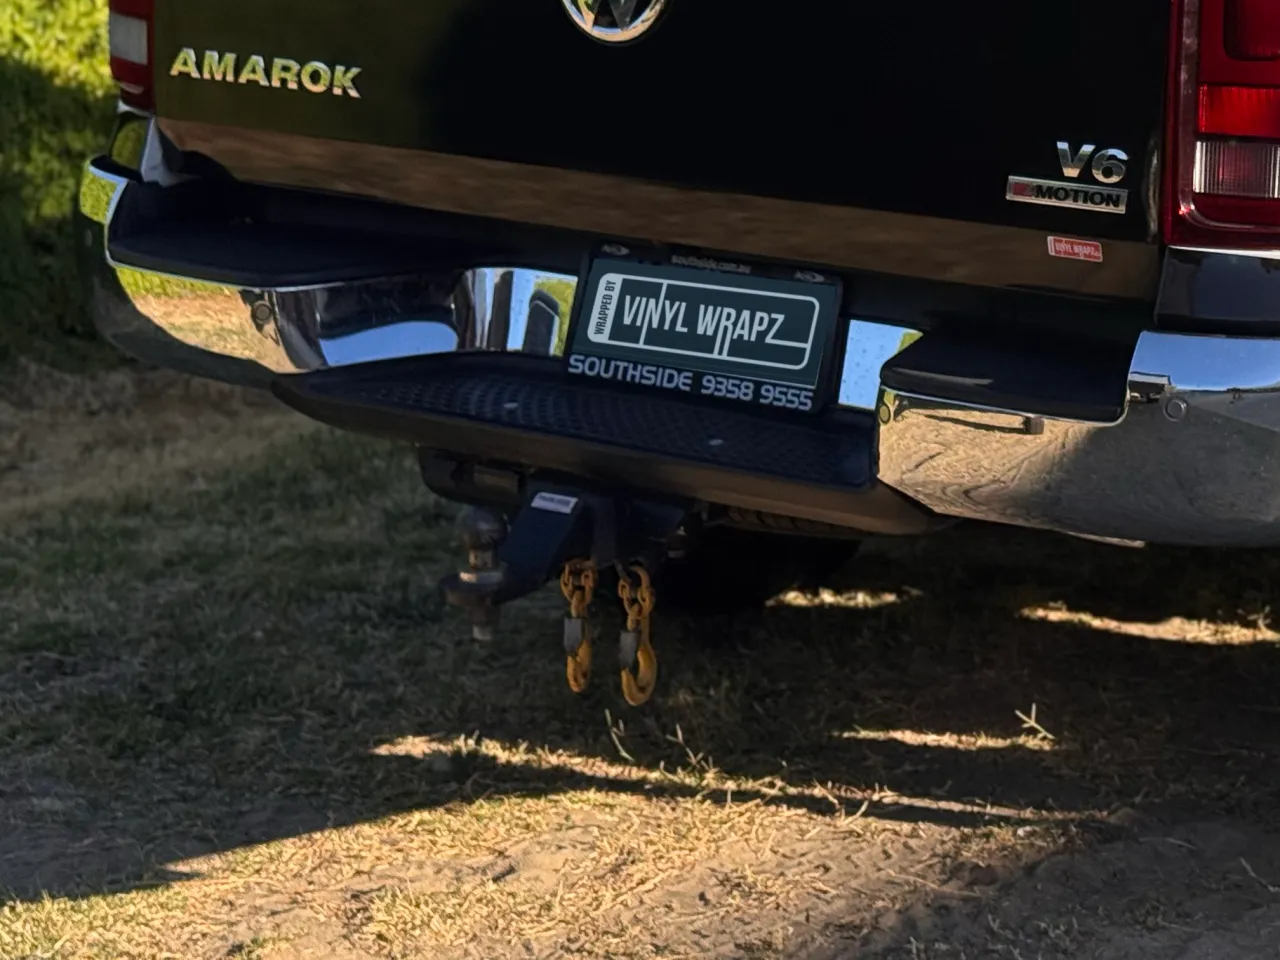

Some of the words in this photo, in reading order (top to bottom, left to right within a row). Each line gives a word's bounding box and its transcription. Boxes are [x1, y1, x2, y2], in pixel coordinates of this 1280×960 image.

[168, 46, 363, 99] AMAROK
[1056, 140, 1130, 184] V6
[593, 292, 613, 336] WRAPPED
[604, 279, 617, 293] BY
[622, 290, 689, 338] VINYL
[697, 304, 788, 347] WRAPZ
[567, 353, 694, 392] SOUTHSIDE
[700, 374, 755, 402] 9358
[759, 383, 815, 412] 9555
